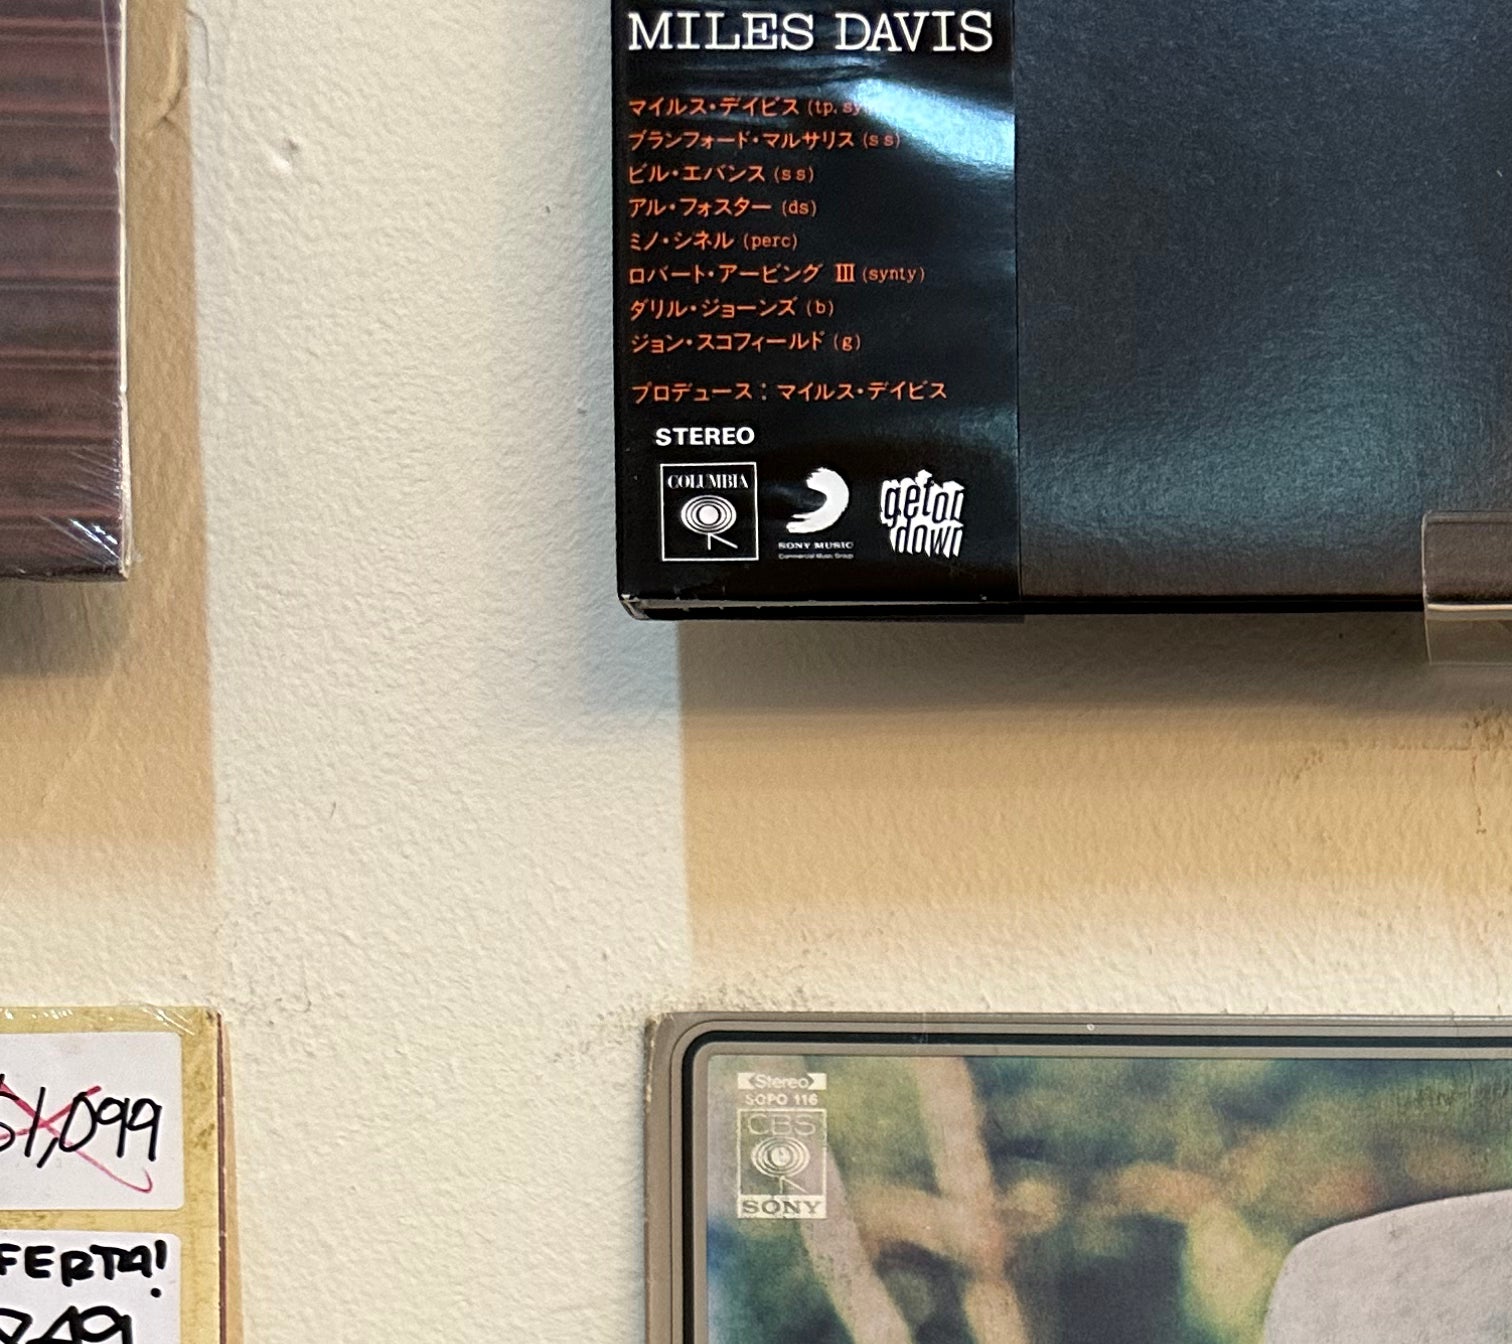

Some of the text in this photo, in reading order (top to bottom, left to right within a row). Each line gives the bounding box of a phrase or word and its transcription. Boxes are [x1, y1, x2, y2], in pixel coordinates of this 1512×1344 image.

[627, 10, 993, 53] MILES DAVIS
[628, 129, 855, 151] ブランフォード・マルサリス
[628, 163, 766, 185] ビル・エバンス
[628, 196, 817, 218] アル・フォスター (ds)
[630, 231, 799, 251] ミノ・シネル (perc)
[628, 263, 824, 284] ロバート・アービング
[630, 296, 835, 322] ダリル・ジョーンズ (b)
[631, 331, 862, 353] ジョン・スコフィールド (g)
[656, 426, 756, 447] STEREO
[667, 473, 750, 490] COLUMBIA
[778, 541, 855, 550] SONY MUSIC
[890, 522, 965, 559] down
[754, 1074, 809, 1089] Stereo
[747, 1112, 817, 1136] CBS
[742, 1200, 822, 1215] SONY
